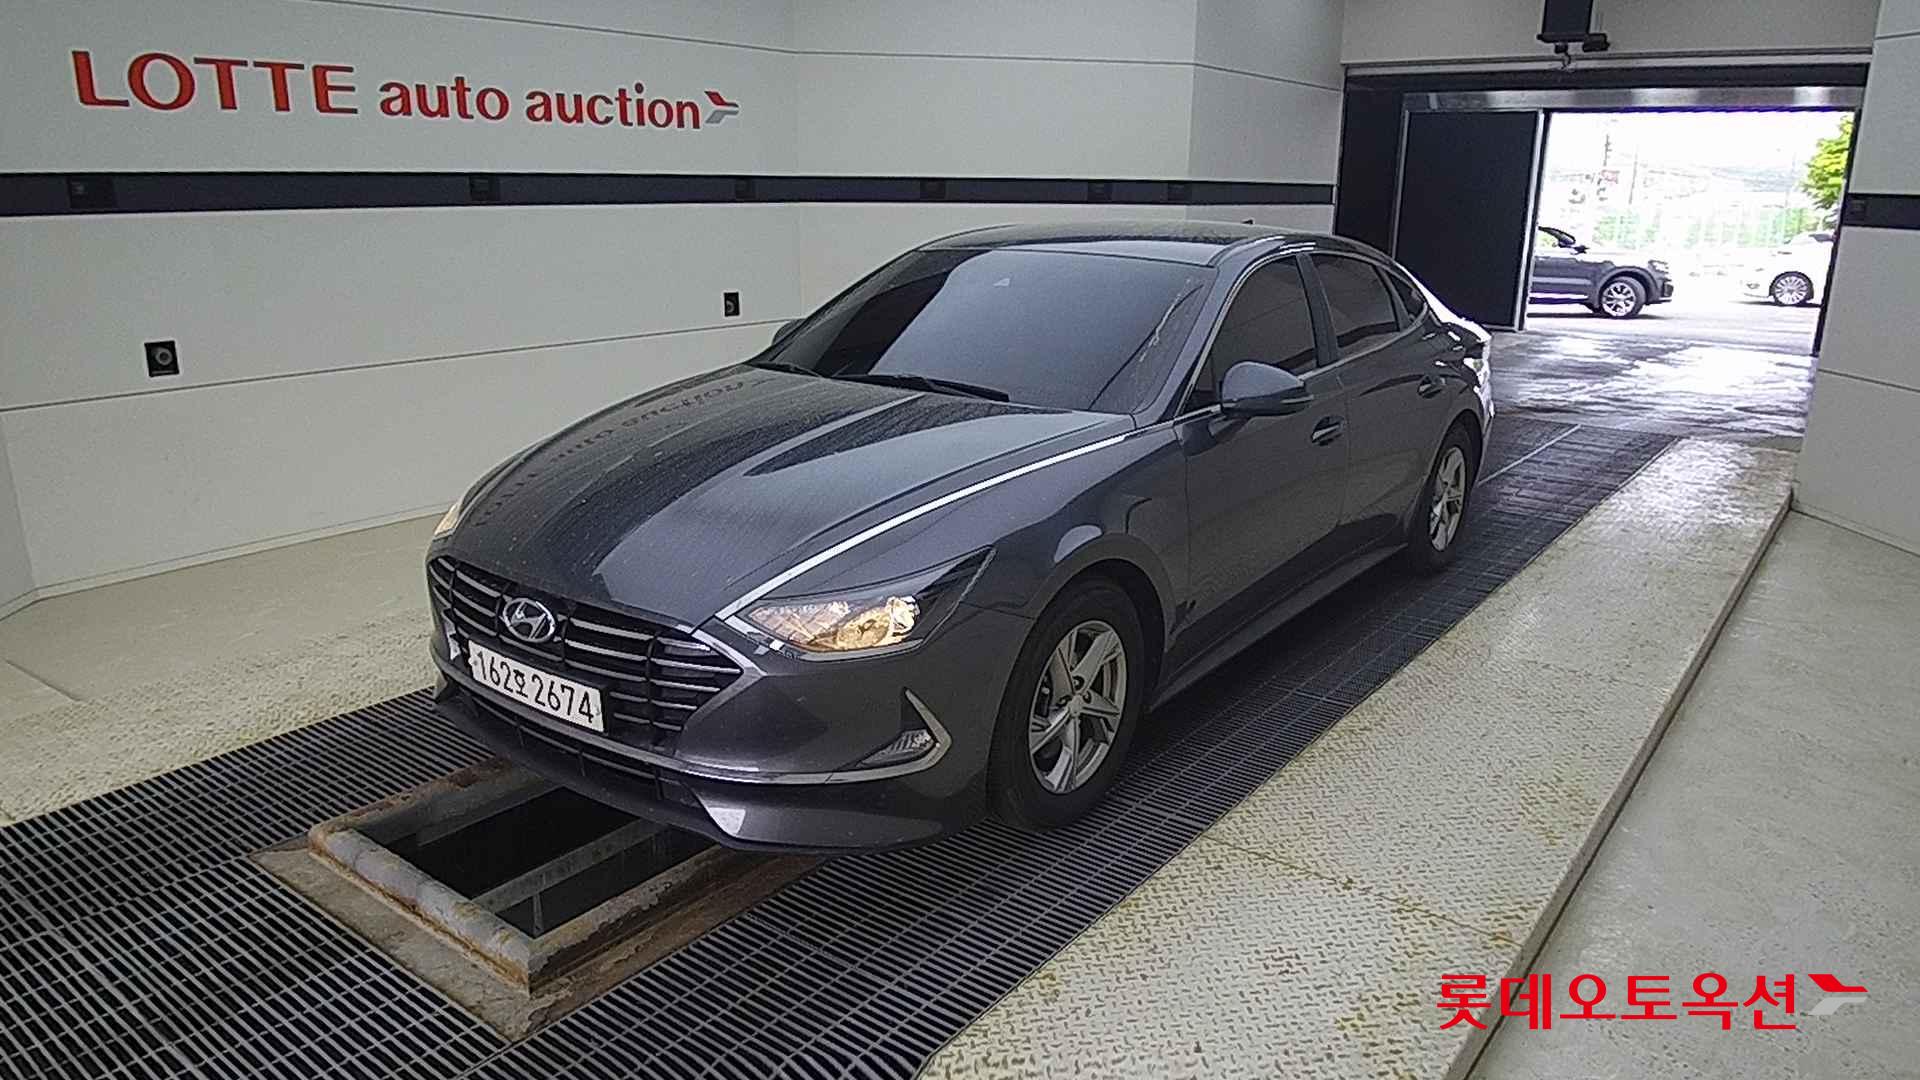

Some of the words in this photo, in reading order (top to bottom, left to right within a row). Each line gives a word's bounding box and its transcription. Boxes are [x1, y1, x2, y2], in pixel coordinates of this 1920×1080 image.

[71, 50, 358, 115] LOTTE
[379, 75, 510, 121] auto
[525, 82, 702, 130] auction
